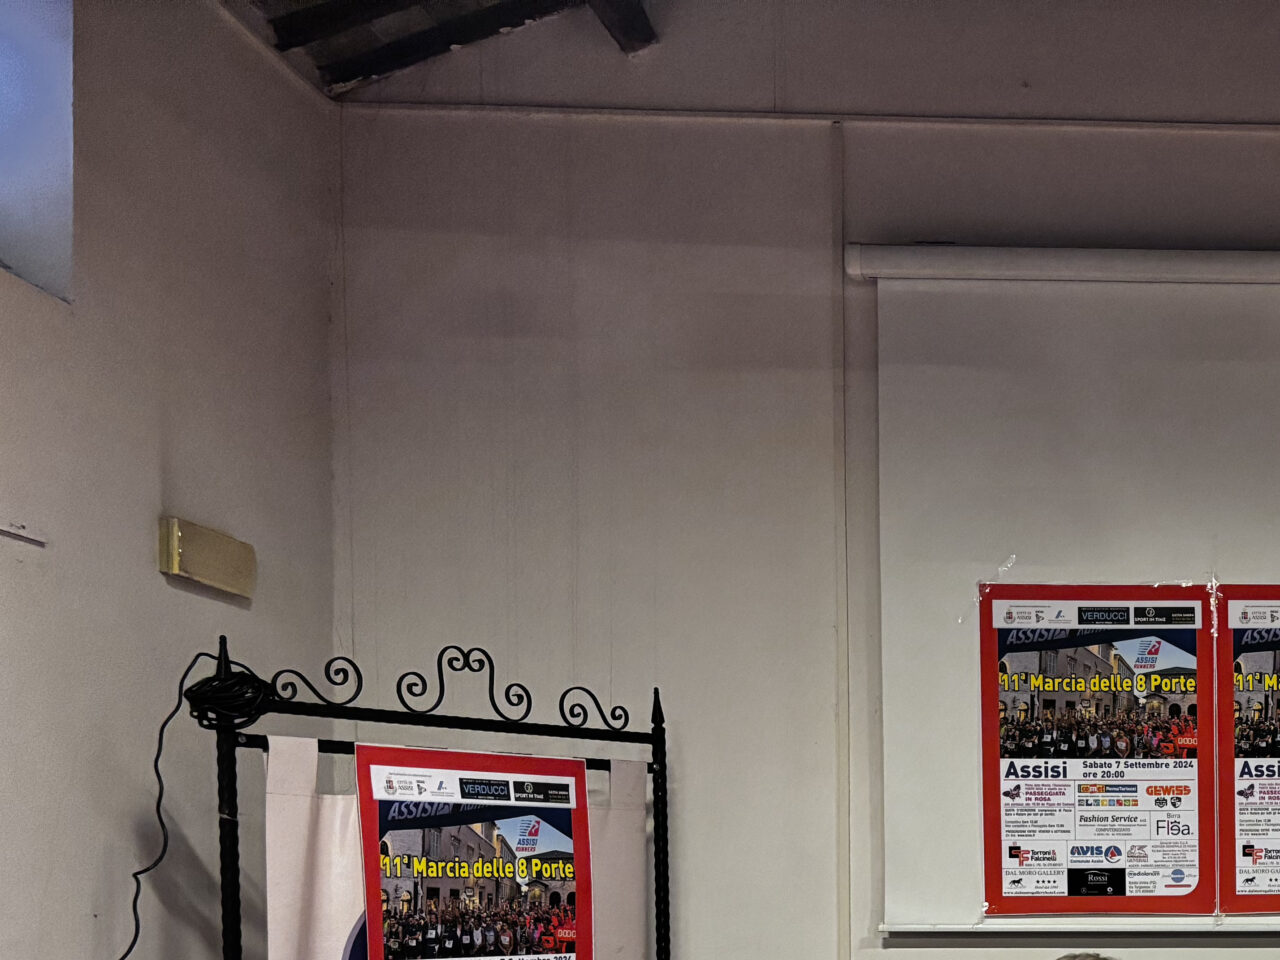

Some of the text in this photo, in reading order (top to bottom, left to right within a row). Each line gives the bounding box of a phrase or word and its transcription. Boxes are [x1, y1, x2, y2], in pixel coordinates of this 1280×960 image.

[1029, 673, 1086, 693] Marcia
[1090, 673, 1132, 692] delle
[1136, 675, 1146, 692] 8
[1151, 674, 1196, 692] Porte
[1004, 761, 1067, 778] Assisi
[1070, 846, 1103, 855] AVIS
[412, 855, 470, 879] Marcia
[473, 856, 514, 879] delle
[518, 858, 528, 878] 8
[532, 858, 573, 879] Porte
